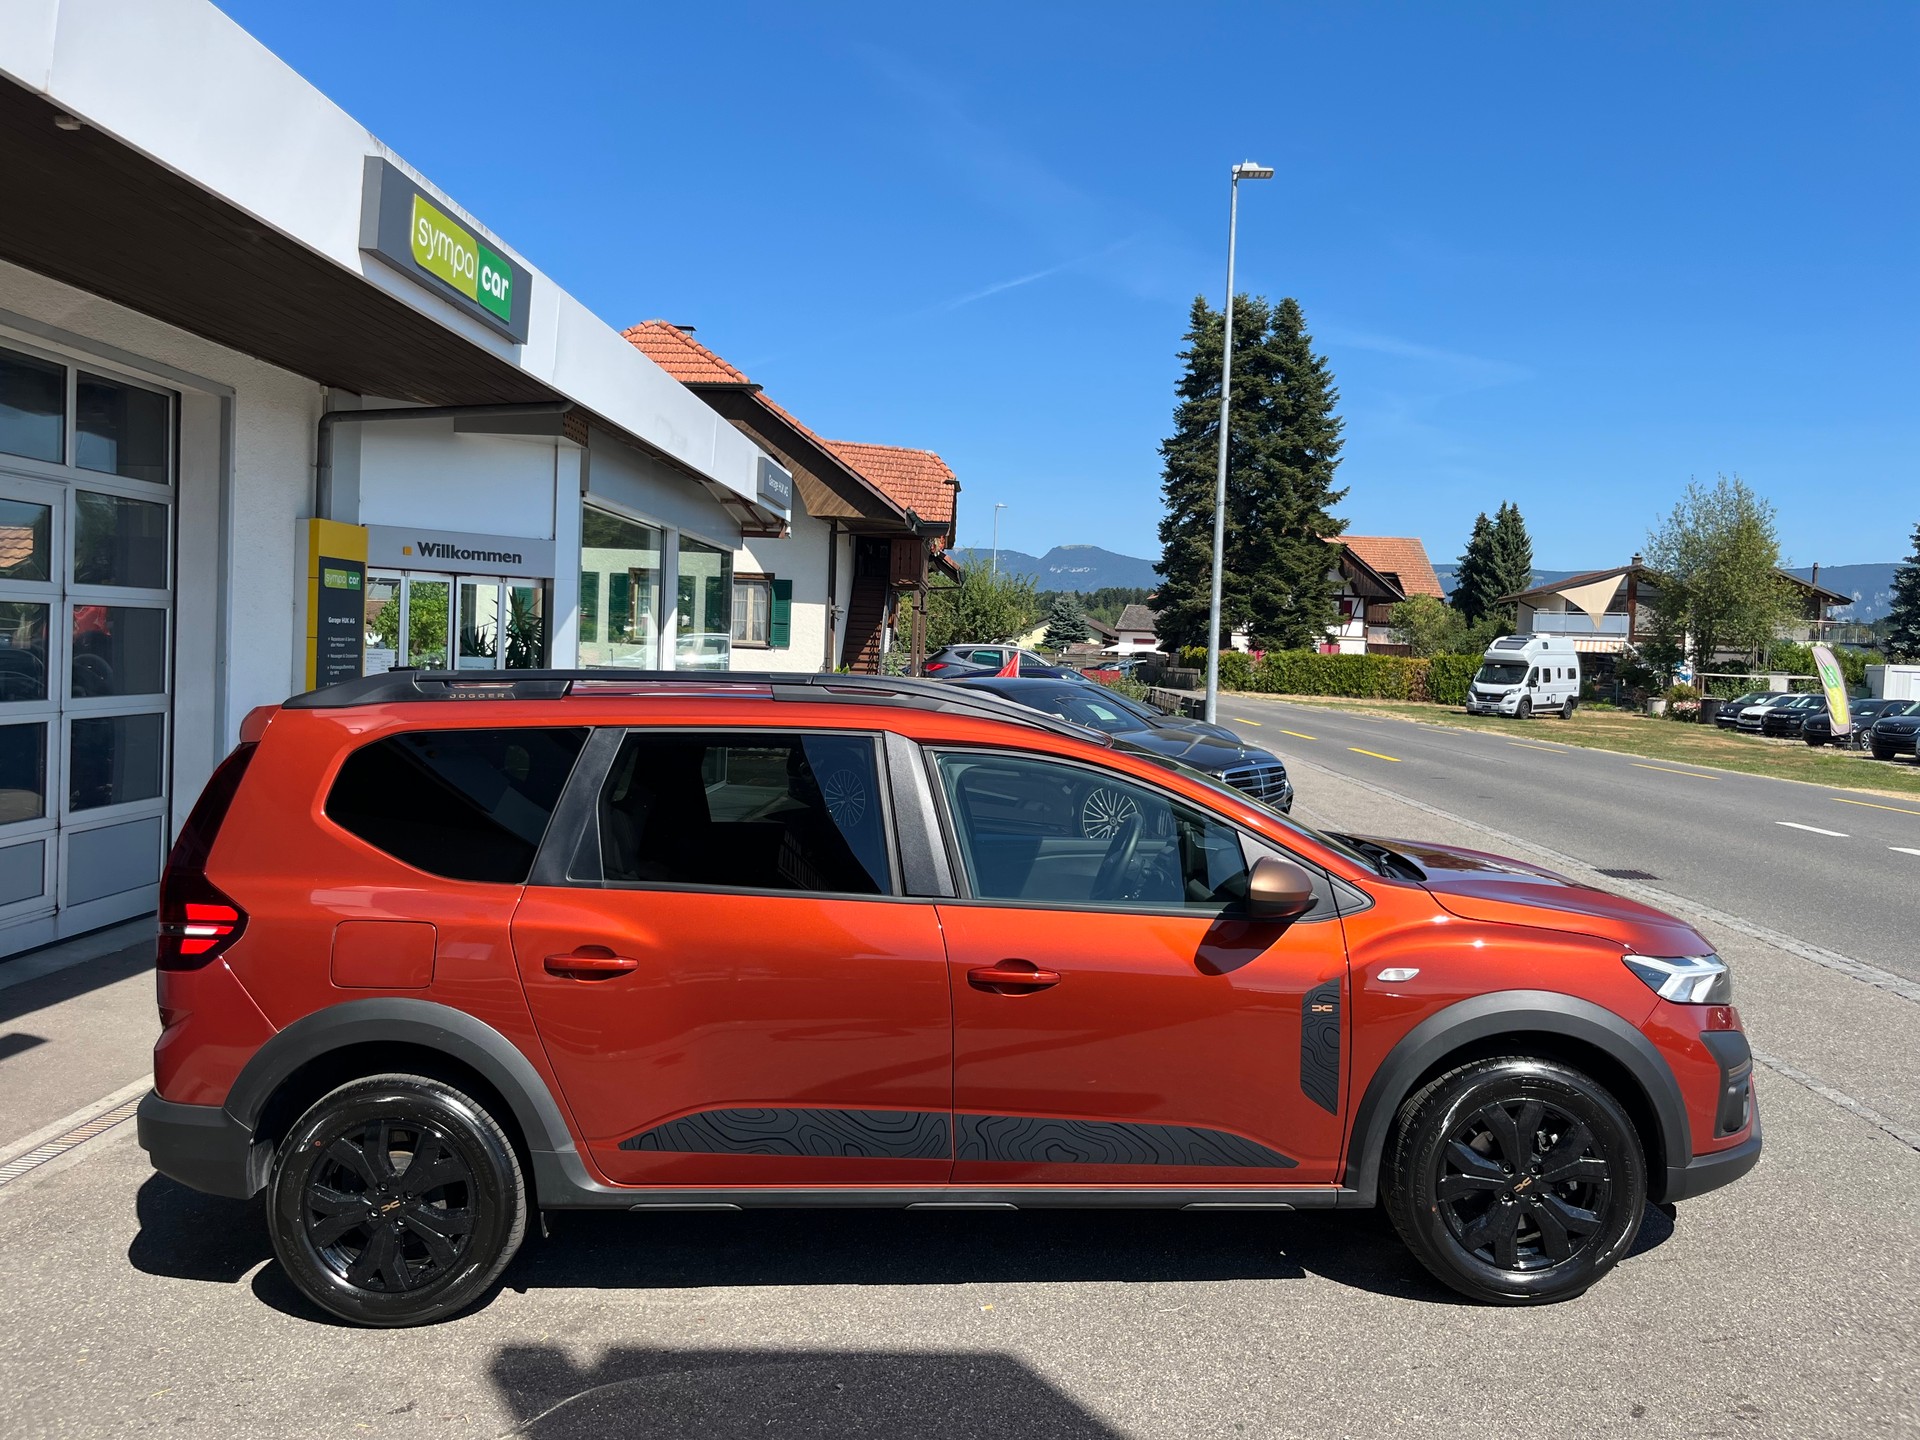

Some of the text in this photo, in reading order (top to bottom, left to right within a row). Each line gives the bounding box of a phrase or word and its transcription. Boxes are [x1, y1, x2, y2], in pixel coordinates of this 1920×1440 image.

[418, 217, 509, 301] sympa car
[417, 541, 522, 564] Willkommen
[325, 573, 360, 585] sympa car
